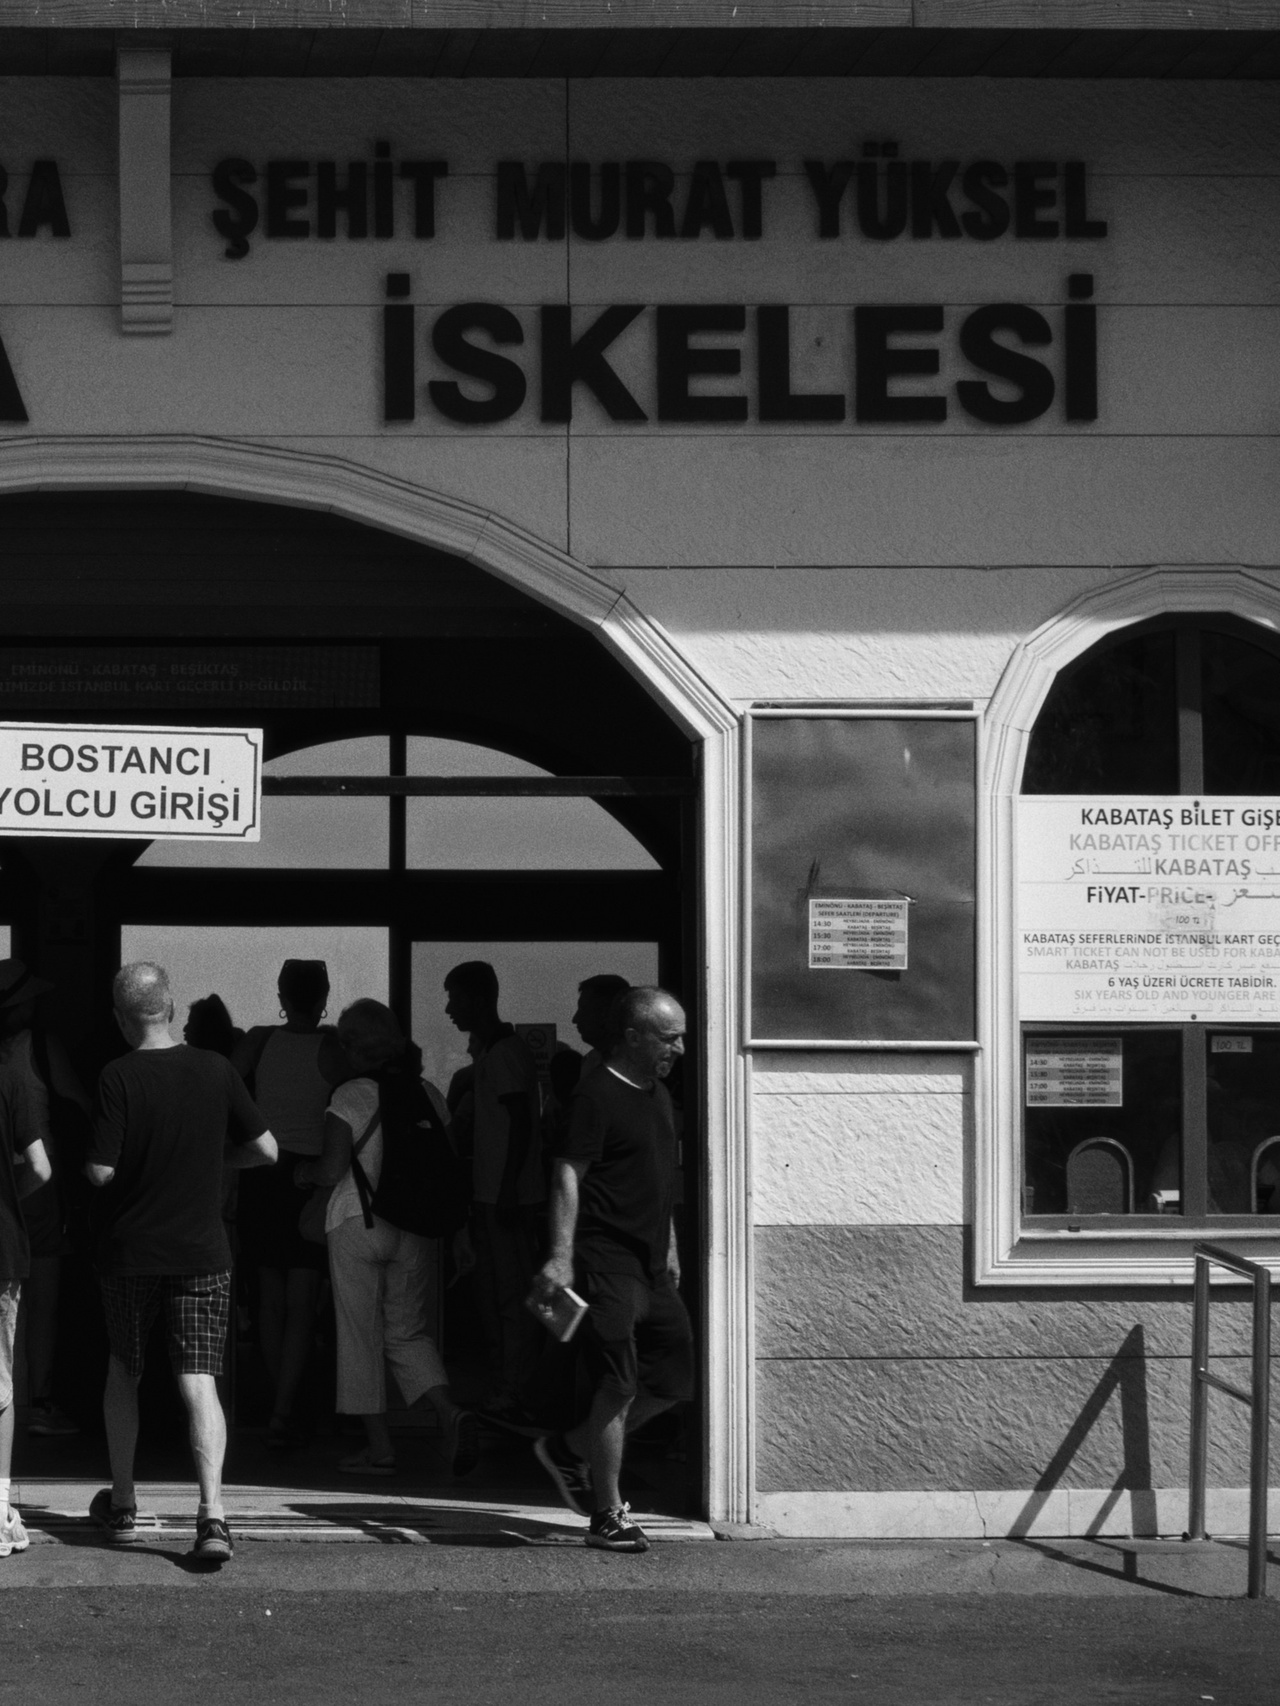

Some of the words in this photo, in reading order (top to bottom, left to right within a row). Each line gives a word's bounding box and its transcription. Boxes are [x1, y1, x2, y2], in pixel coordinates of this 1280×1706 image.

[211, 139, 448, 260] ŞEHİT
[495, 160, 776, 240] MURAT
[805, 140, 1108, 240] YÜKSEL
[384, 273, 1098, 424] İSKELESİ
[20, 743, 211, 776] BOSTANCI
[130, 785, 240, 828] GİRİŞİ
[1082, 808, 1173, 829] KABATAŞ
[1070, 834, 1161, 854] KABATAŞ
[1169, 834, 1238, 851] TICKET
[1156, 859, 1251, 879] KABATAŞ
[1024, 934, 1075, 944] KABATAŞ
[1225, 934, 1254, 944] KART
[1027, 947, 1069, 957] SMART
[1073, 947, 1113, 957] TICKET
[1115, 947, 1139, 957] CAN
[1144, 947, 1168, 957] NOT
[1172, 947, 1185, 957] BE
[1189, 947, 1220, 957] USED
[1224, 947, 1247, 957] FOR
[1066, 960, 1119, 971] KABATAŞ
[1109, 977, 1115, 987] 6
[1119, 977, 1139, 990] YAŞ
[1143, 976, 1176, 987] ÜZERİ
[1180, 976, 1224, 987] ÜCRETE
[1074, 991, 1091, 1000] SIX
[1096, 991, 1132, 1000] YEARS
[1136, 991, 1159, 1000] OLD
[1162, 991, 1189, 1000] AND
[1192, 991, 1249, 1000] YOUNGER
[1253, 991, 1275, 1000] ARE
